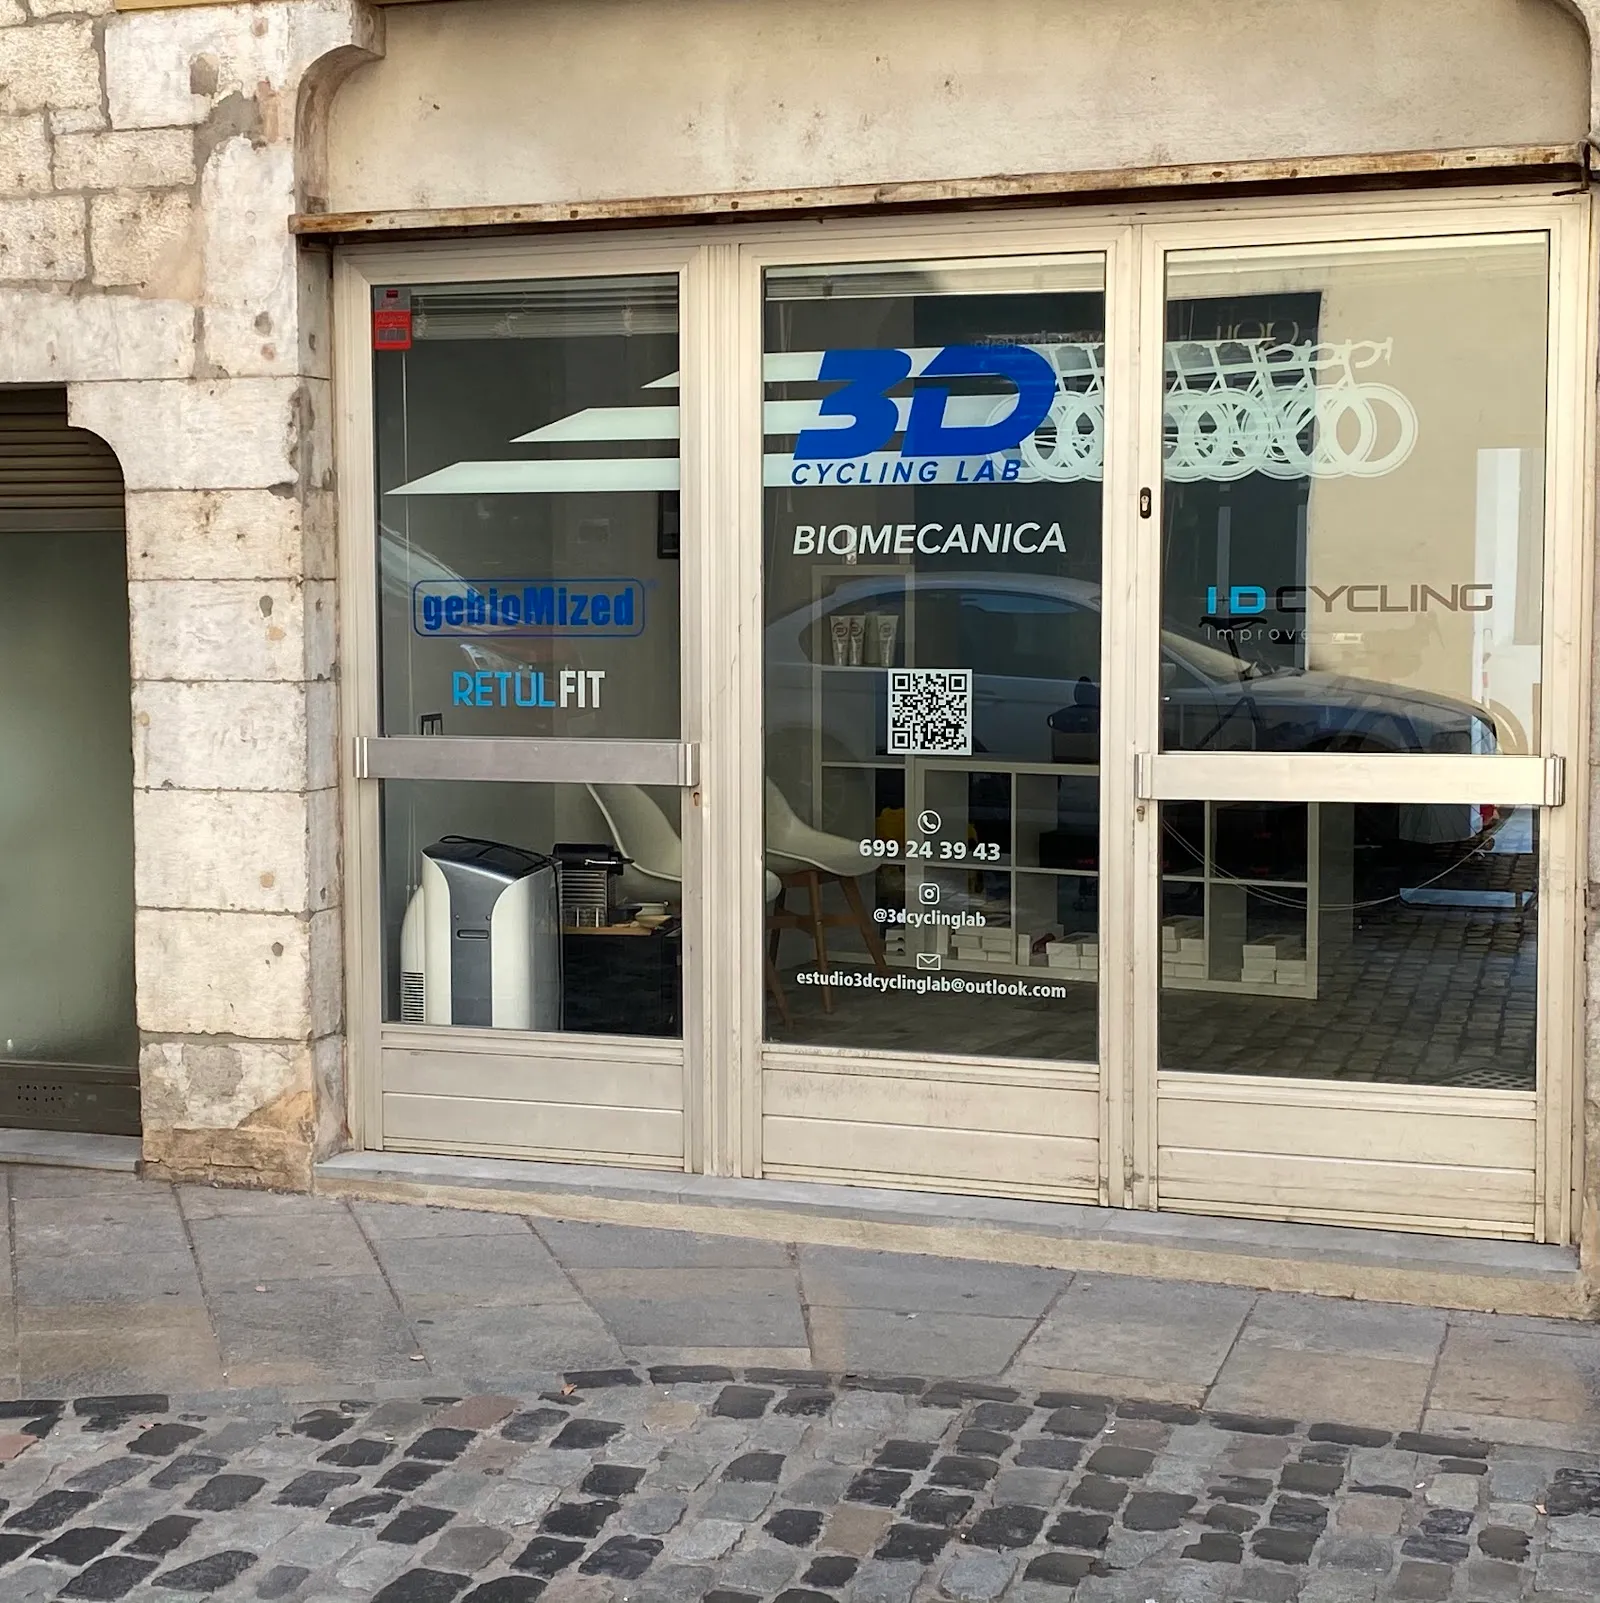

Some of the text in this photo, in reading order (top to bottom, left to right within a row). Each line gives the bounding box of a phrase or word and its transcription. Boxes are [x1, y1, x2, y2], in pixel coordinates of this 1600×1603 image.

[793, 343, 1057, 460] 3D
[791, 459, 1022, 485] CYCLING LAB
[792, 522, 1067, 555] BIOMECANICA
[423, 587, 634, 631] gebioMized
[1276, 584, 1493, 613] CYCLING
[859, 838, 1001, 861] 699 24 39 43
[873, 908, 987, 930] @3dcyclinglab
[796, 971, 1067, 998] estudio3dcyclinglab@outlook.com
